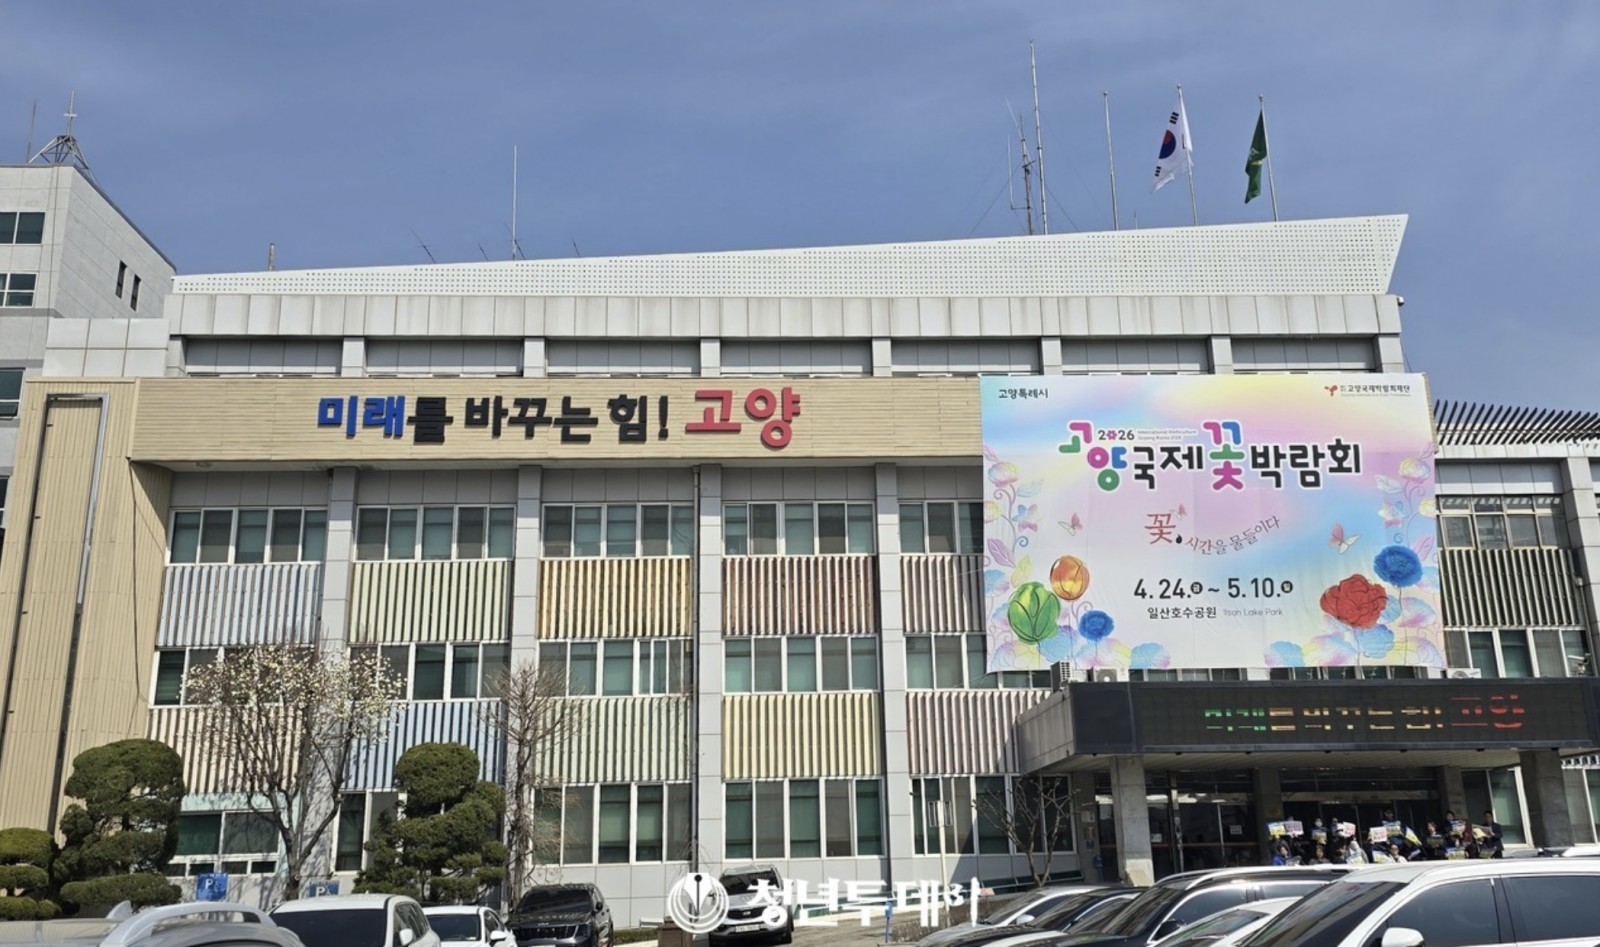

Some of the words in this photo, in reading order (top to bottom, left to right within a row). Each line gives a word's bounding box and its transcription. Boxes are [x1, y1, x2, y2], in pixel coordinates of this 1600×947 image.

[998, 387, 1049, 399] 고양특례시
[318, 395, 454, 443] 미래를
[464, 395, 598, 443] 바꾸는
[607, 394, 669, 443] 힘!
[685, 387, 801, 450] 고양
[1185, 536, 1227, 555] 시간을
[1229, 515, 1281, 552] 물들이다
[1147, 606, 1217, 619] 일산호수공원
[1265, 607, 1283, 616] Park
